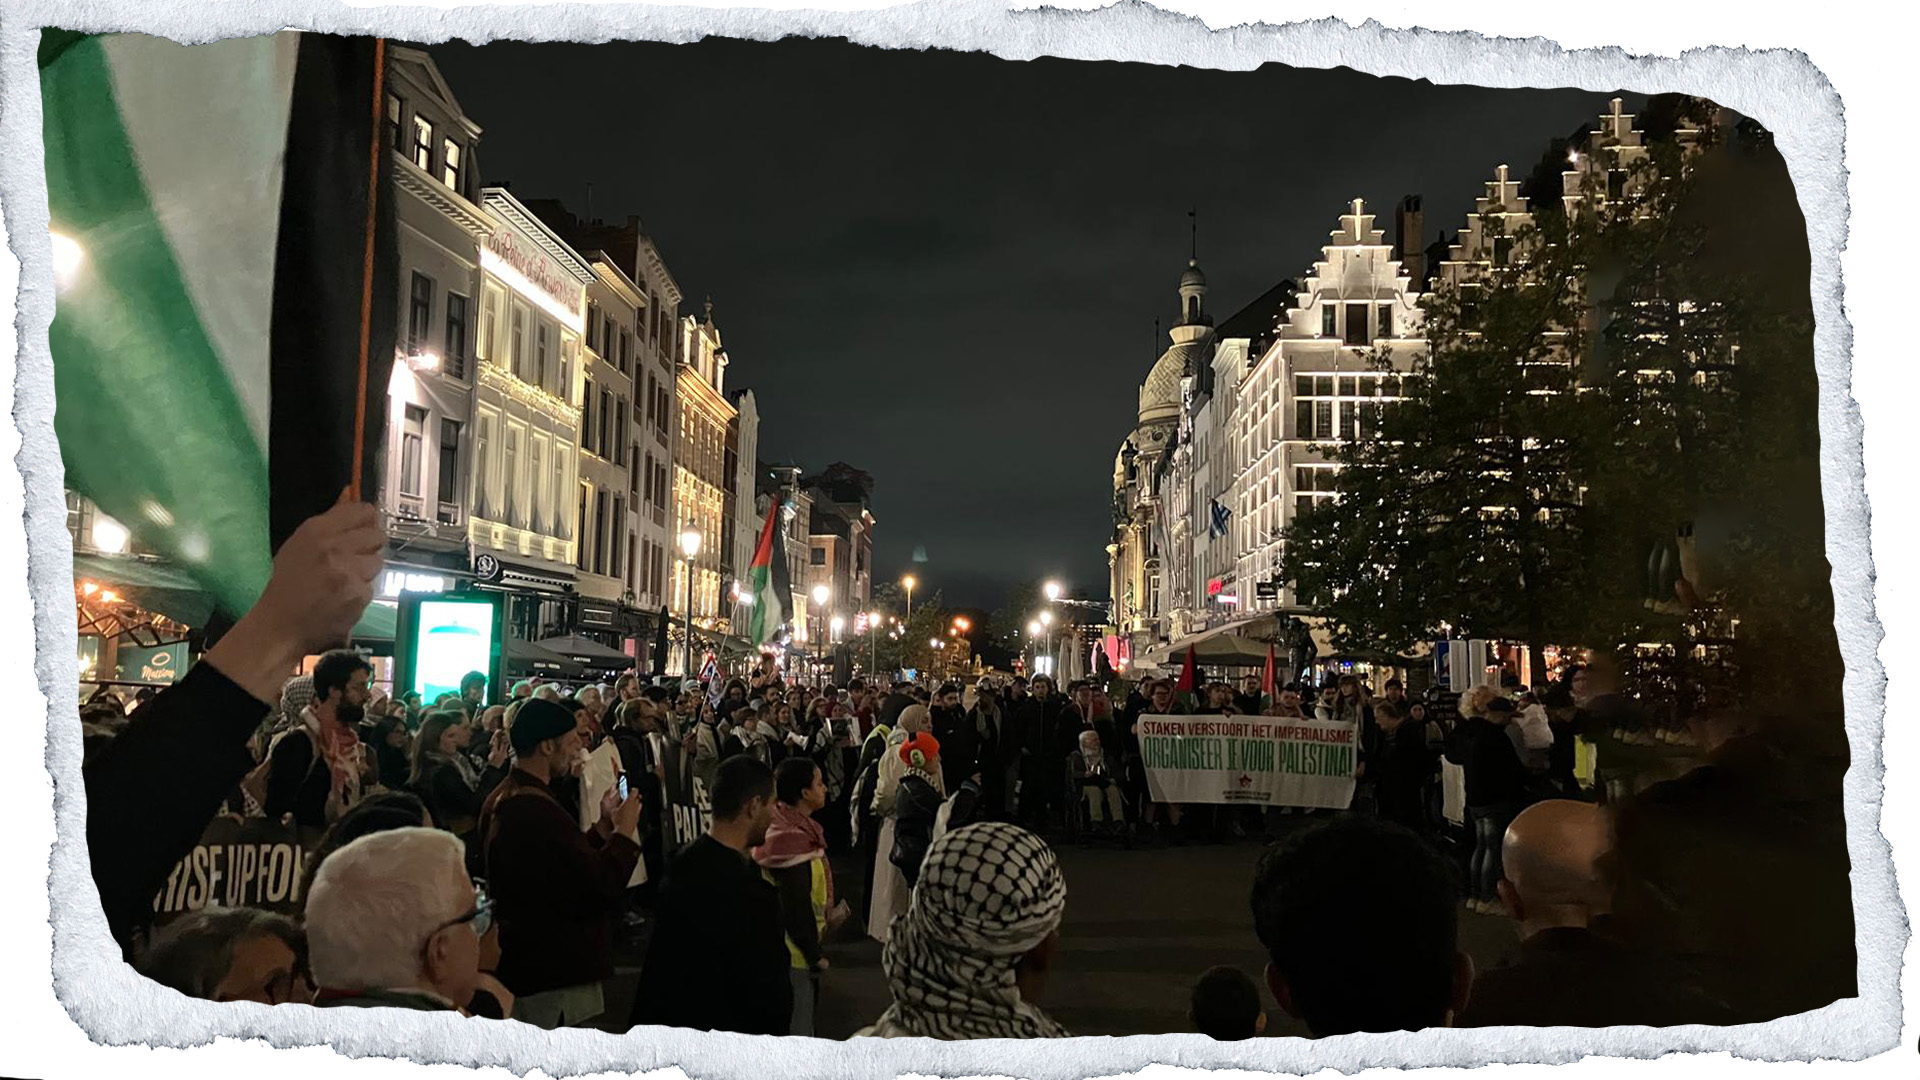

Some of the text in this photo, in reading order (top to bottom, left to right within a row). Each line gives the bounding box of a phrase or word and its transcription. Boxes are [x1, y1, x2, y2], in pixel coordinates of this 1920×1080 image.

[1143, 721, 1353, 744] STAKEN VERSTOORT HET IMPERIALISME
[1144, 736, 1353, 778] ORGANISEER JE VOOR PALESTINA!
